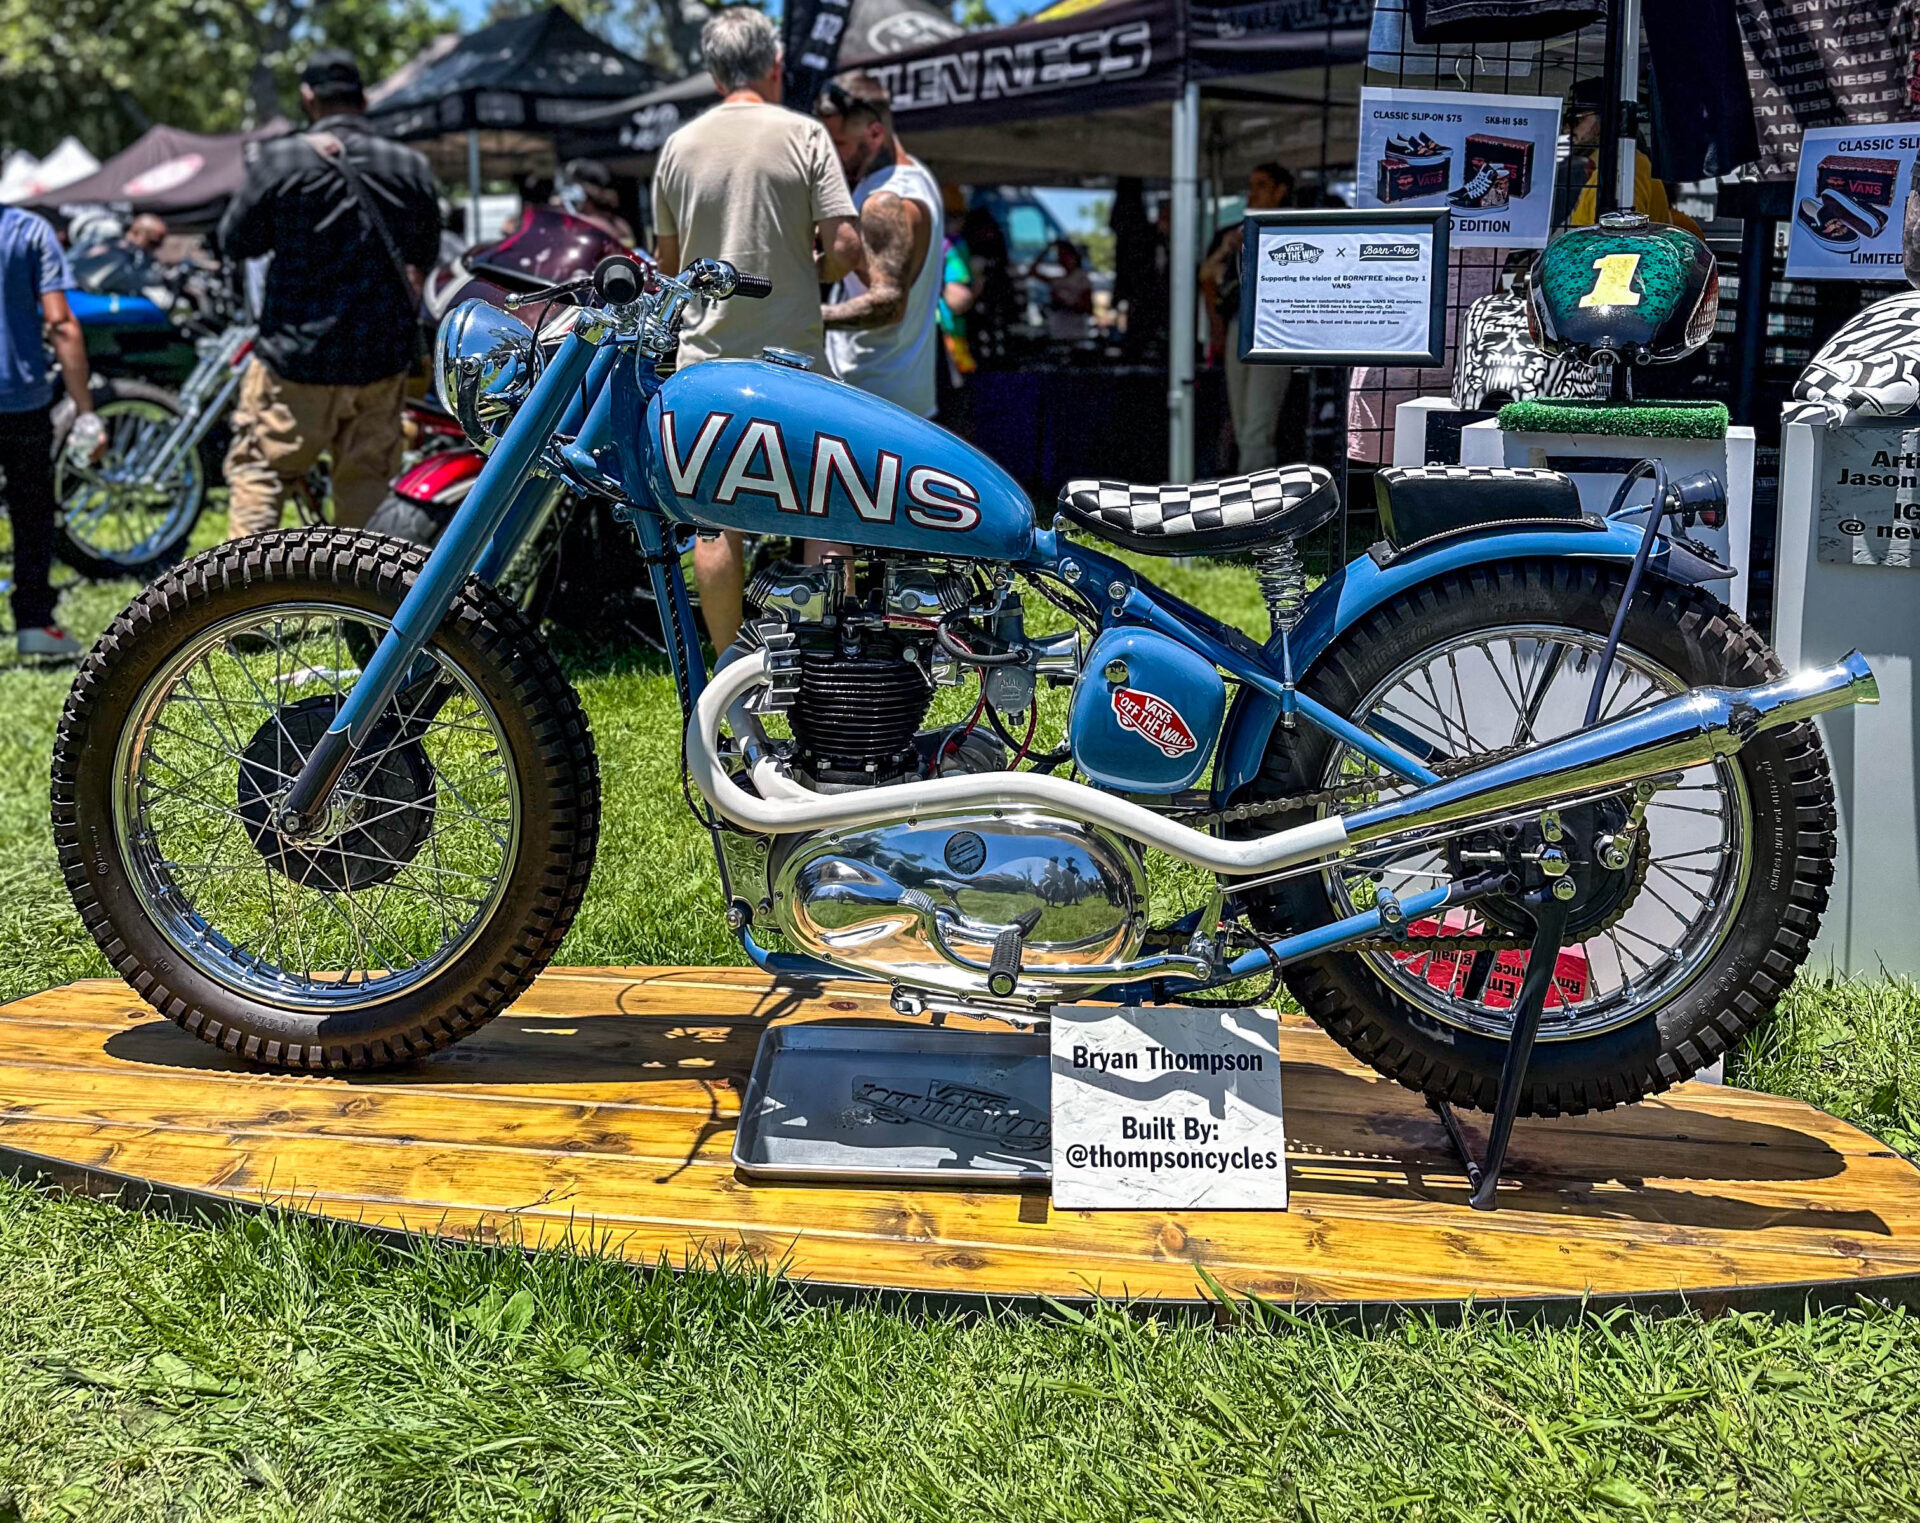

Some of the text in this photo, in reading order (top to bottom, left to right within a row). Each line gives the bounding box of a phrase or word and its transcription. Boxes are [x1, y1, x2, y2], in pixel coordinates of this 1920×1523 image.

[1824, 30, 1886, 49] NESS
[1827, 70, 1888, 88] NESS
[1373, 110, 1463, 123] CLASSIC SLIP-ON $75
[1512, 117, 1529, 127] $85
[1838, 138, 1895, 152] CLASSIC
[1417, 170, 1443, 187] VANS
[1848, 180, 1883, 195] VANS
[1459, 220, 1511, 233] EDITION
[1850, 253, 1904, 265] LIMITED
[1260, 275, 1297, 283] Supporting
[1405, 276, 1420, 284] Day
[1579, 254, 1641, 308] 1
[661, 410, 983, 533] VANS
[1837, 468, 1918, 488] Jason
[1144, 697, 1173, 724] VANS
[1138, 708, 1163, 736] THE
[1073, 1045, 1264, 1075] Bryan Thompson
[1122, 1116, 1219, 1145] Built By:
[1066, 1144, 1278, 1174] @thompsoncycles
